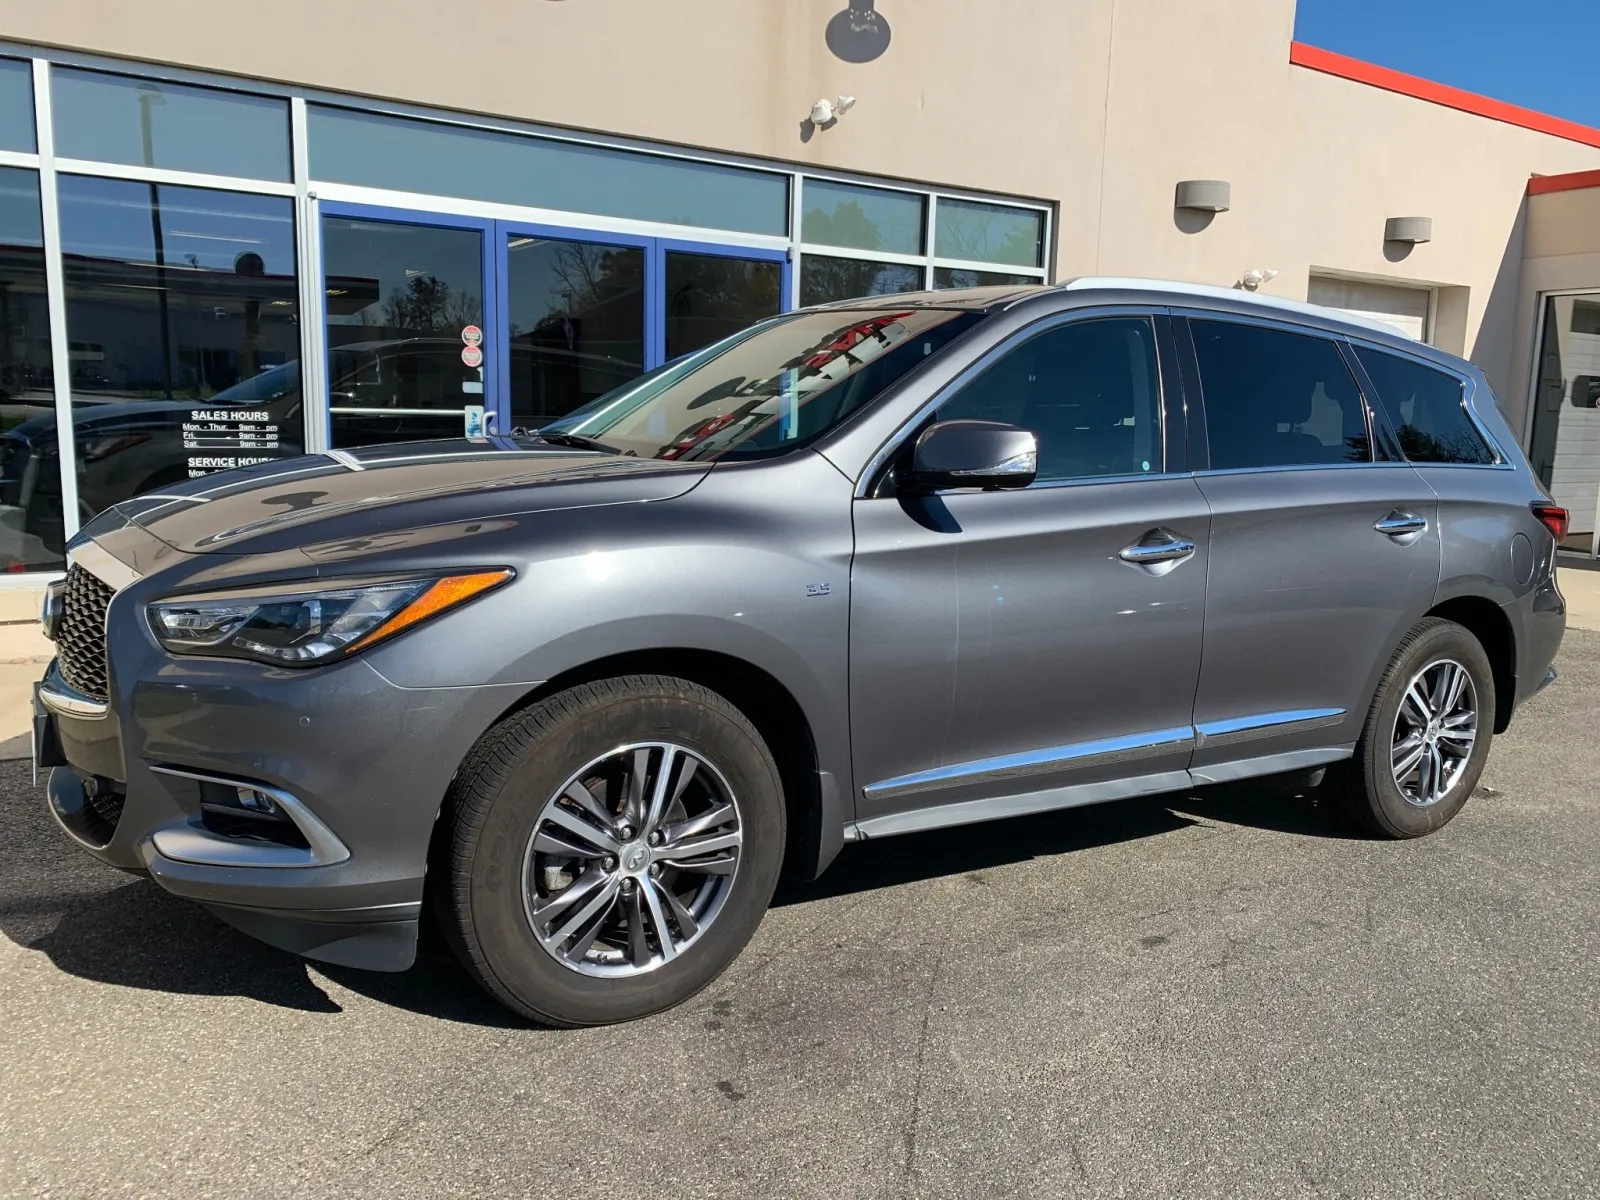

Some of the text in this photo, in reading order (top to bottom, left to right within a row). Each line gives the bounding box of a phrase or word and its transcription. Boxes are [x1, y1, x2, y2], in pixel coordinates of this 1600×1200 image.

[191, 410, 269, 421] SALES HOURS
[182, 423, 202, 431] Mon.
[208, 423, 228, 431] Thur.
[182, 432, 196, 440] Fri.
[238, 432, 255, 440] 9am
[183, 440, 199, 448] Sat.
[239, 440, 256, 448] 9am
[187, 457, 275, 468] SERVICE HOU
